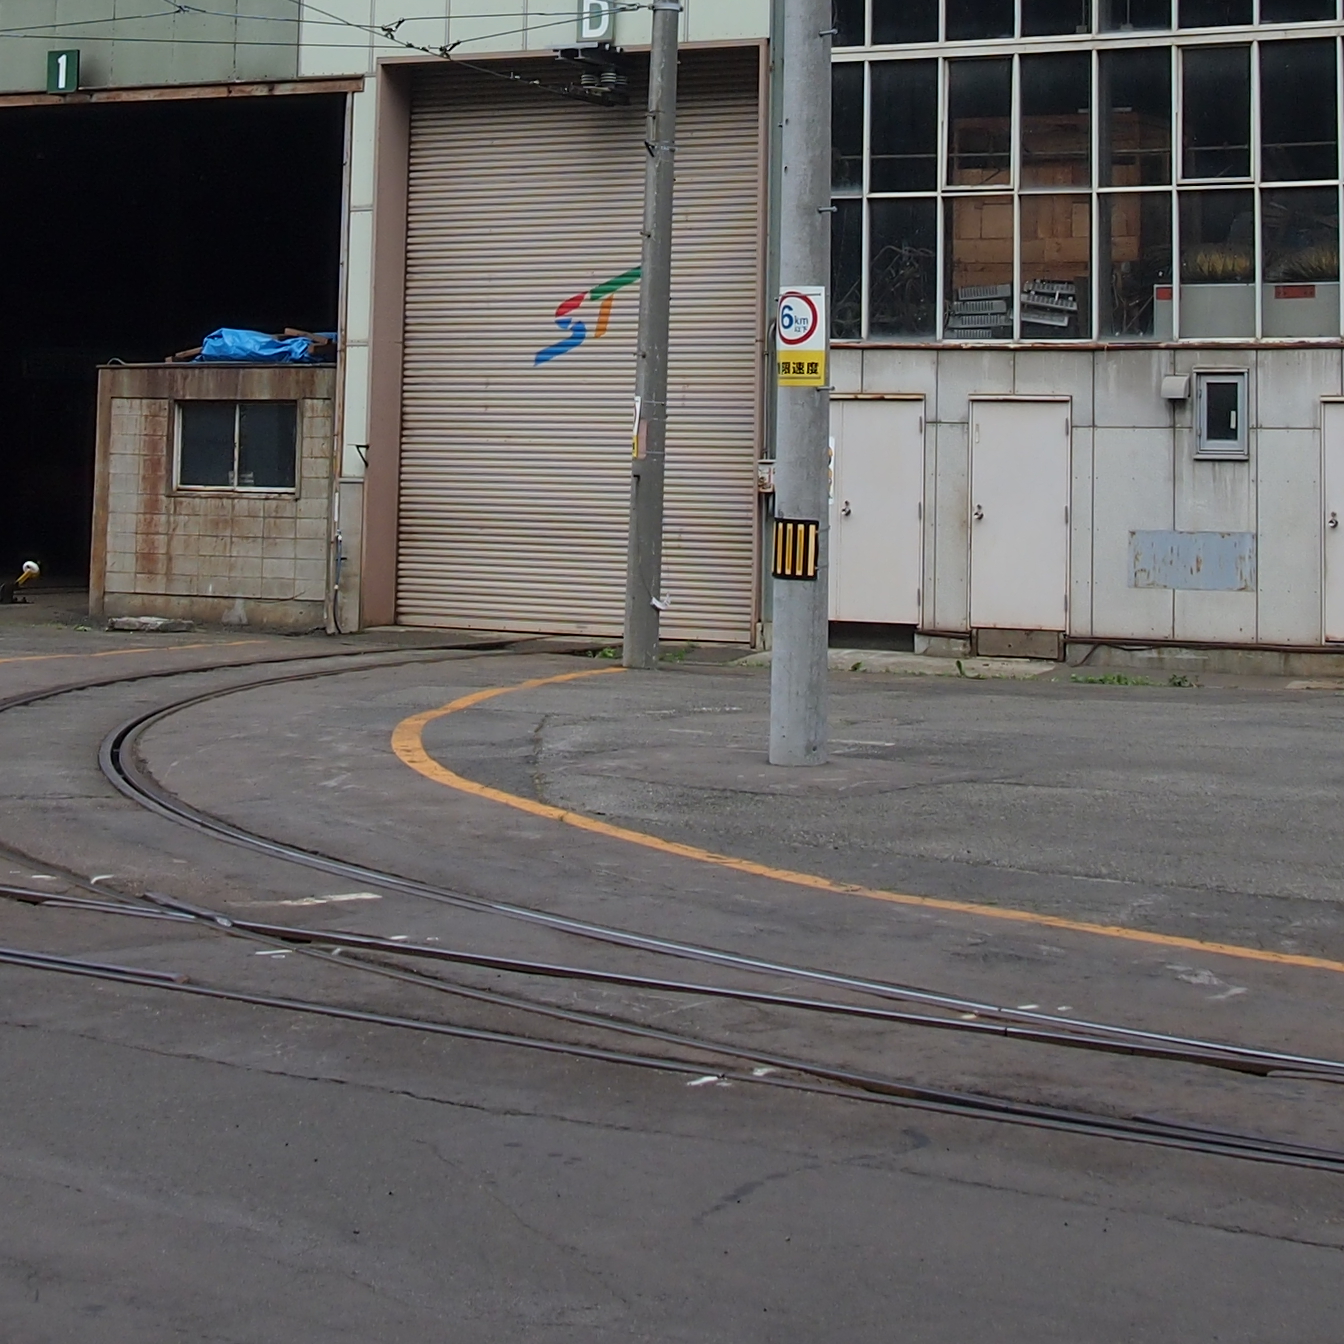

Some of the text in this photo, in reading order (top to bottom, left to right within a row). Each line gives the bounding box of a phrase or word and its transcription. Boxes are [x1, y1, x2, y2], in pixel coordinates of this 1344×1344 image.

[57, 54, 67, 89] 1
[782, 305, 808, 329] 6 km
[778, 362, 818, 374] 限速度
